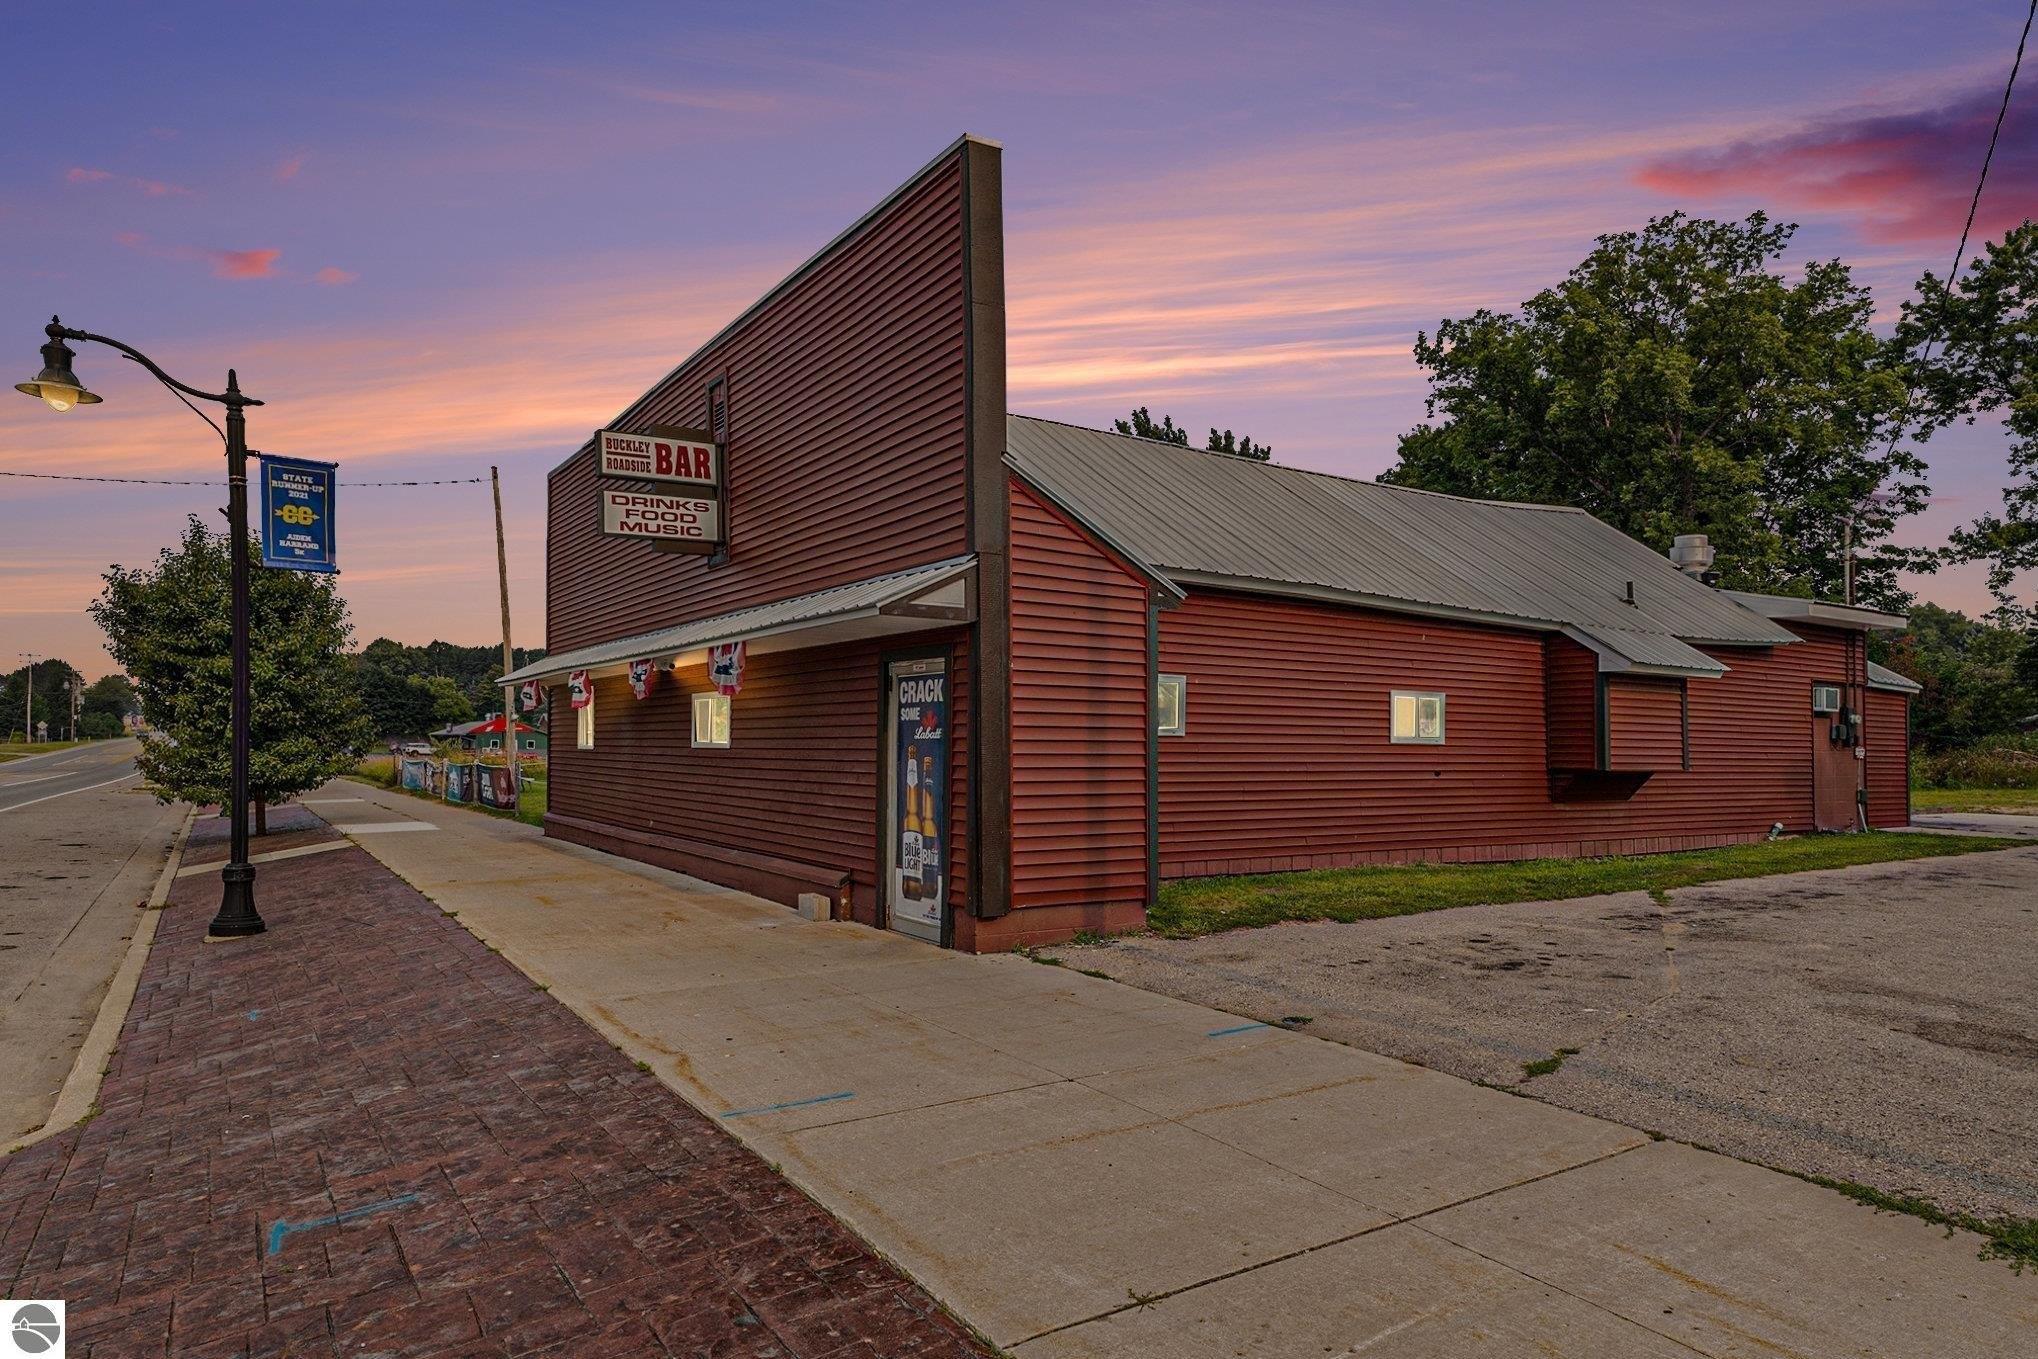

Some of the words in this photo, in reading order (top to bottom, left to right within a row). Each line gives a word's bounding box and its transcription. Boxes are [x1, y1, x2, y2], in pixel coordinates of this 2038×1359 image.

[605, 437, 651, 454] BUCKLEY
[606, 457, 652, 474] ROADSIDE
[654, 442, 712, 480] BAR
[271, 479, 325, 493] RUNNER-UP
[282, 473, 314, 484] STATE
[287, 490, 309, 500] 2021
[611, 494, 710, 513] DRINKS
[625, 508, 698, 524] FOOD
[619, 520, 703, 537] MUSIC
[899, 678, 944, 704] CRACK
[900, 707, 921, 721] SOME
[913, 726, 943, 740] Labatt
[904, 843, 921, 859] Blue
[904, 857, 921, 872] LIGHT
